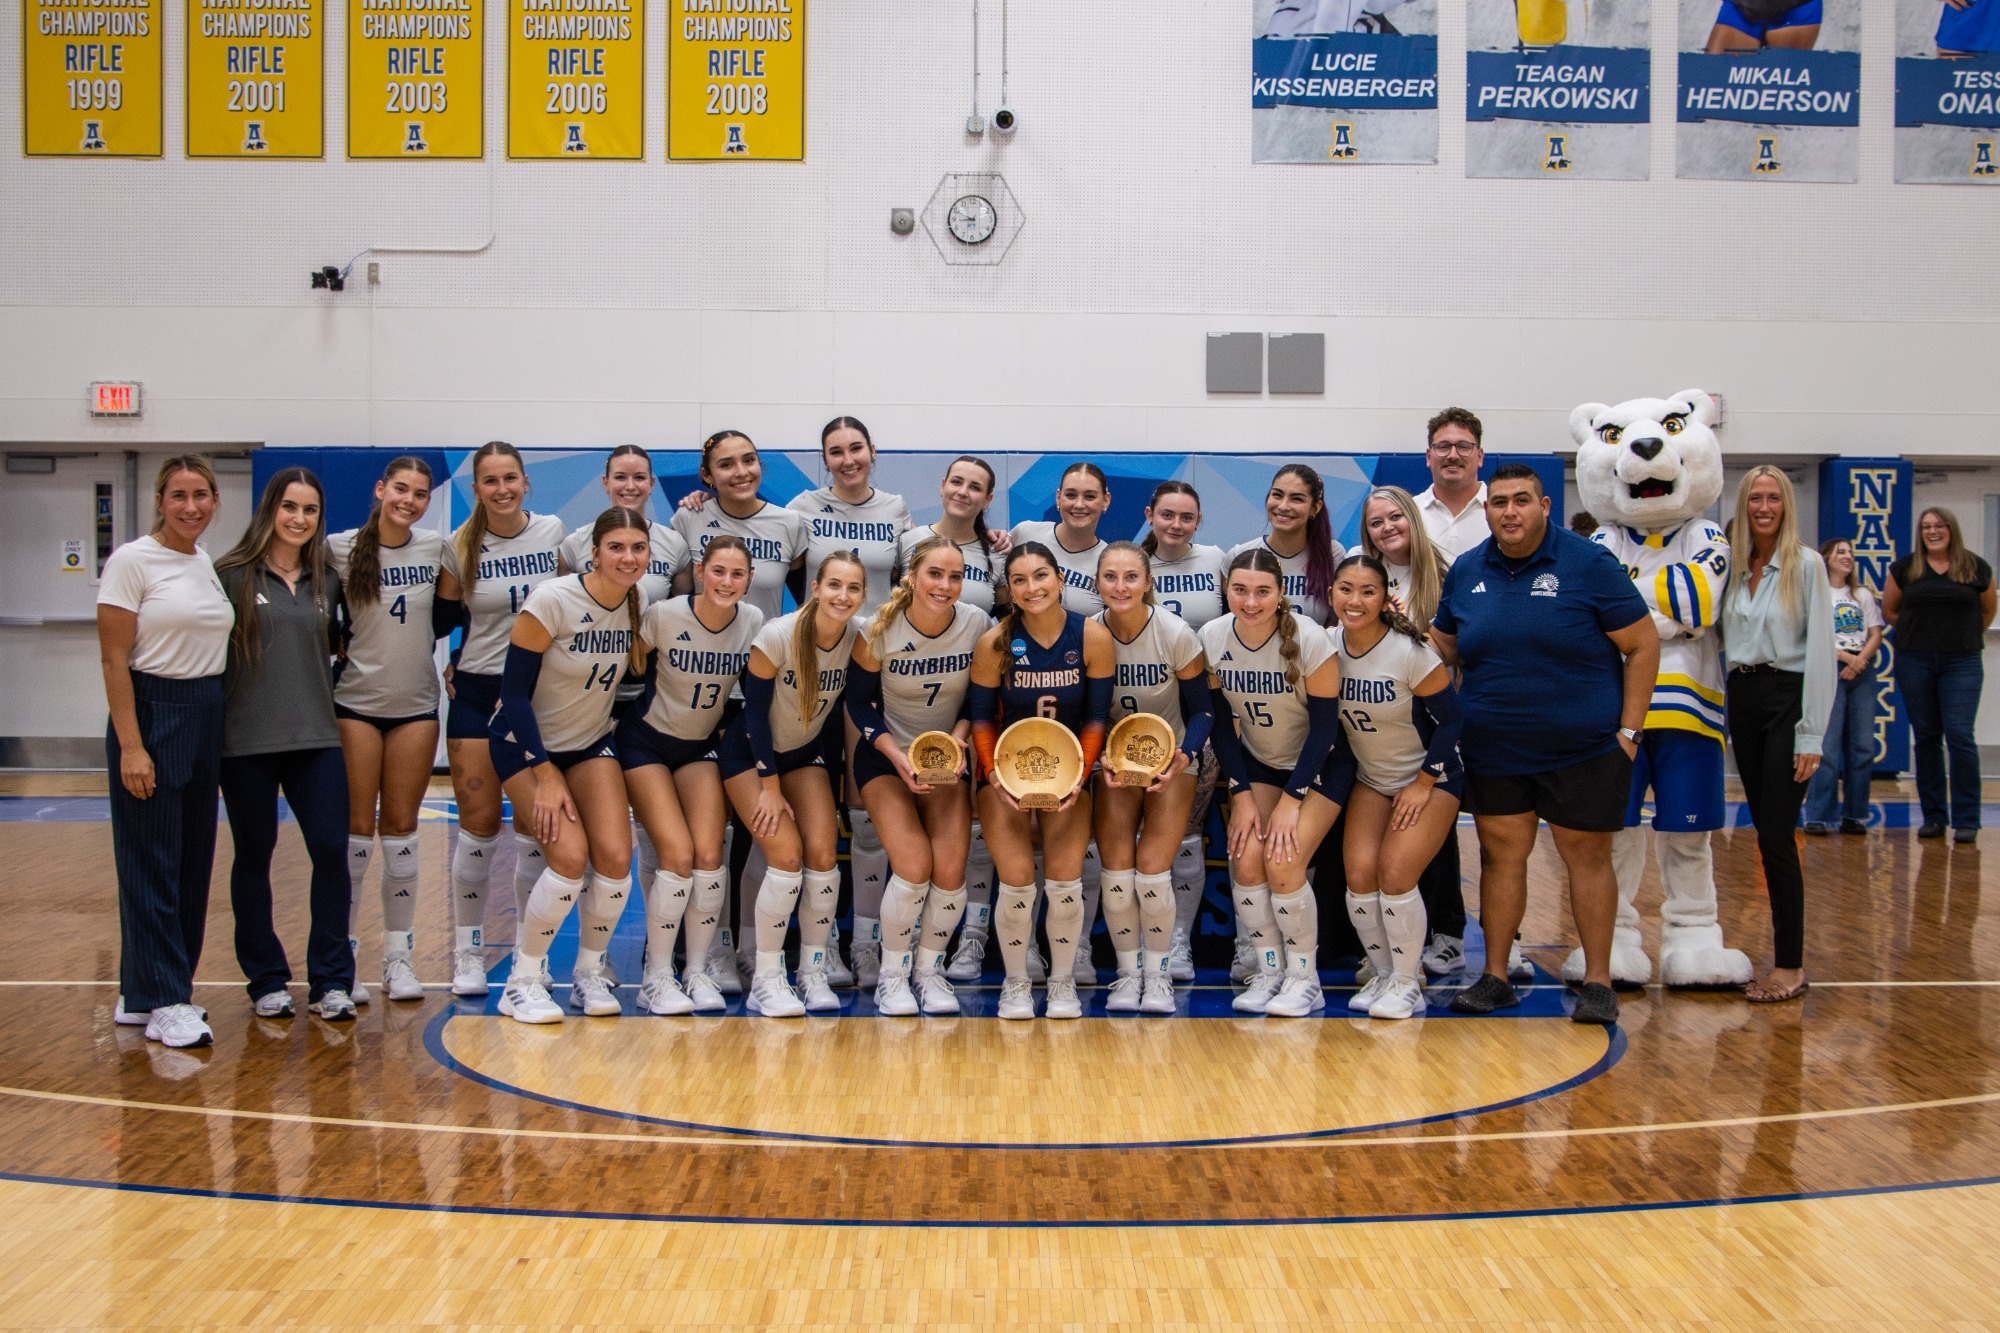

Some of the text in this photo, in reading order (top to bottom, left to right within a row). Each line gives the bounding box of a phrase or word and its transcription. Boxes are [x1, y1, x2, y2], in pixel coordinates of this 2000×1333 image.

[39, 10, 149, 36] CHAMPIONS
[202, 12, 311, 38] CHAMPIONS
[363, 14, 471, 39] CHAMPIONS
[523, 15, 631, 40] CHAMPIONS
[684, 16, 792, 41] CHAMPIONS
[65, 44, 123, 72] RIFLE
[227, 46, 285, 74] RIFLE
[387, 47, 445, 75] RIFLE
[548, 48, 606, 76] RIFLE
[708, 49, 766, 77] RIFLE
[1311, 53, 1377, 72] LUCIE
[1515, 65, 1605, 83] TEAGAN
[1728, 67, 1811, 86] MIKALA
[67, 79, 122, 110] 1999
[228, 80, 285, 112] 2001
[386, 82, 447, 113] 2003
[546, 82, 607, 114] 2006
[706, 84, 768, 115] 2008
[1253, 78, 1436, 99] KISSENBERGER
[1478, 86, 1639, 110] PERKOWSKI
[1686, 88, 1850, 113] HENDERSON
[1938, 92, 2000, 114] ONA
[97, 386, 132, 411] EXIT
[812, 518, 894, 544] SUNBIRDS
[389, 595, 408, 624] 4
[585, 662, 619, 692] 14
[1014, 668, 1080, 688] SUNBIRDS
[691, 682, 722, 710] 13
[923, 682, 943, 707] 7
[1036, 694, 1058, 719] 6
[1120, 695, 1139, 717] 9
[1244, 701, 1274, 728] 15
[1341, 709, 1378, 732] 12
